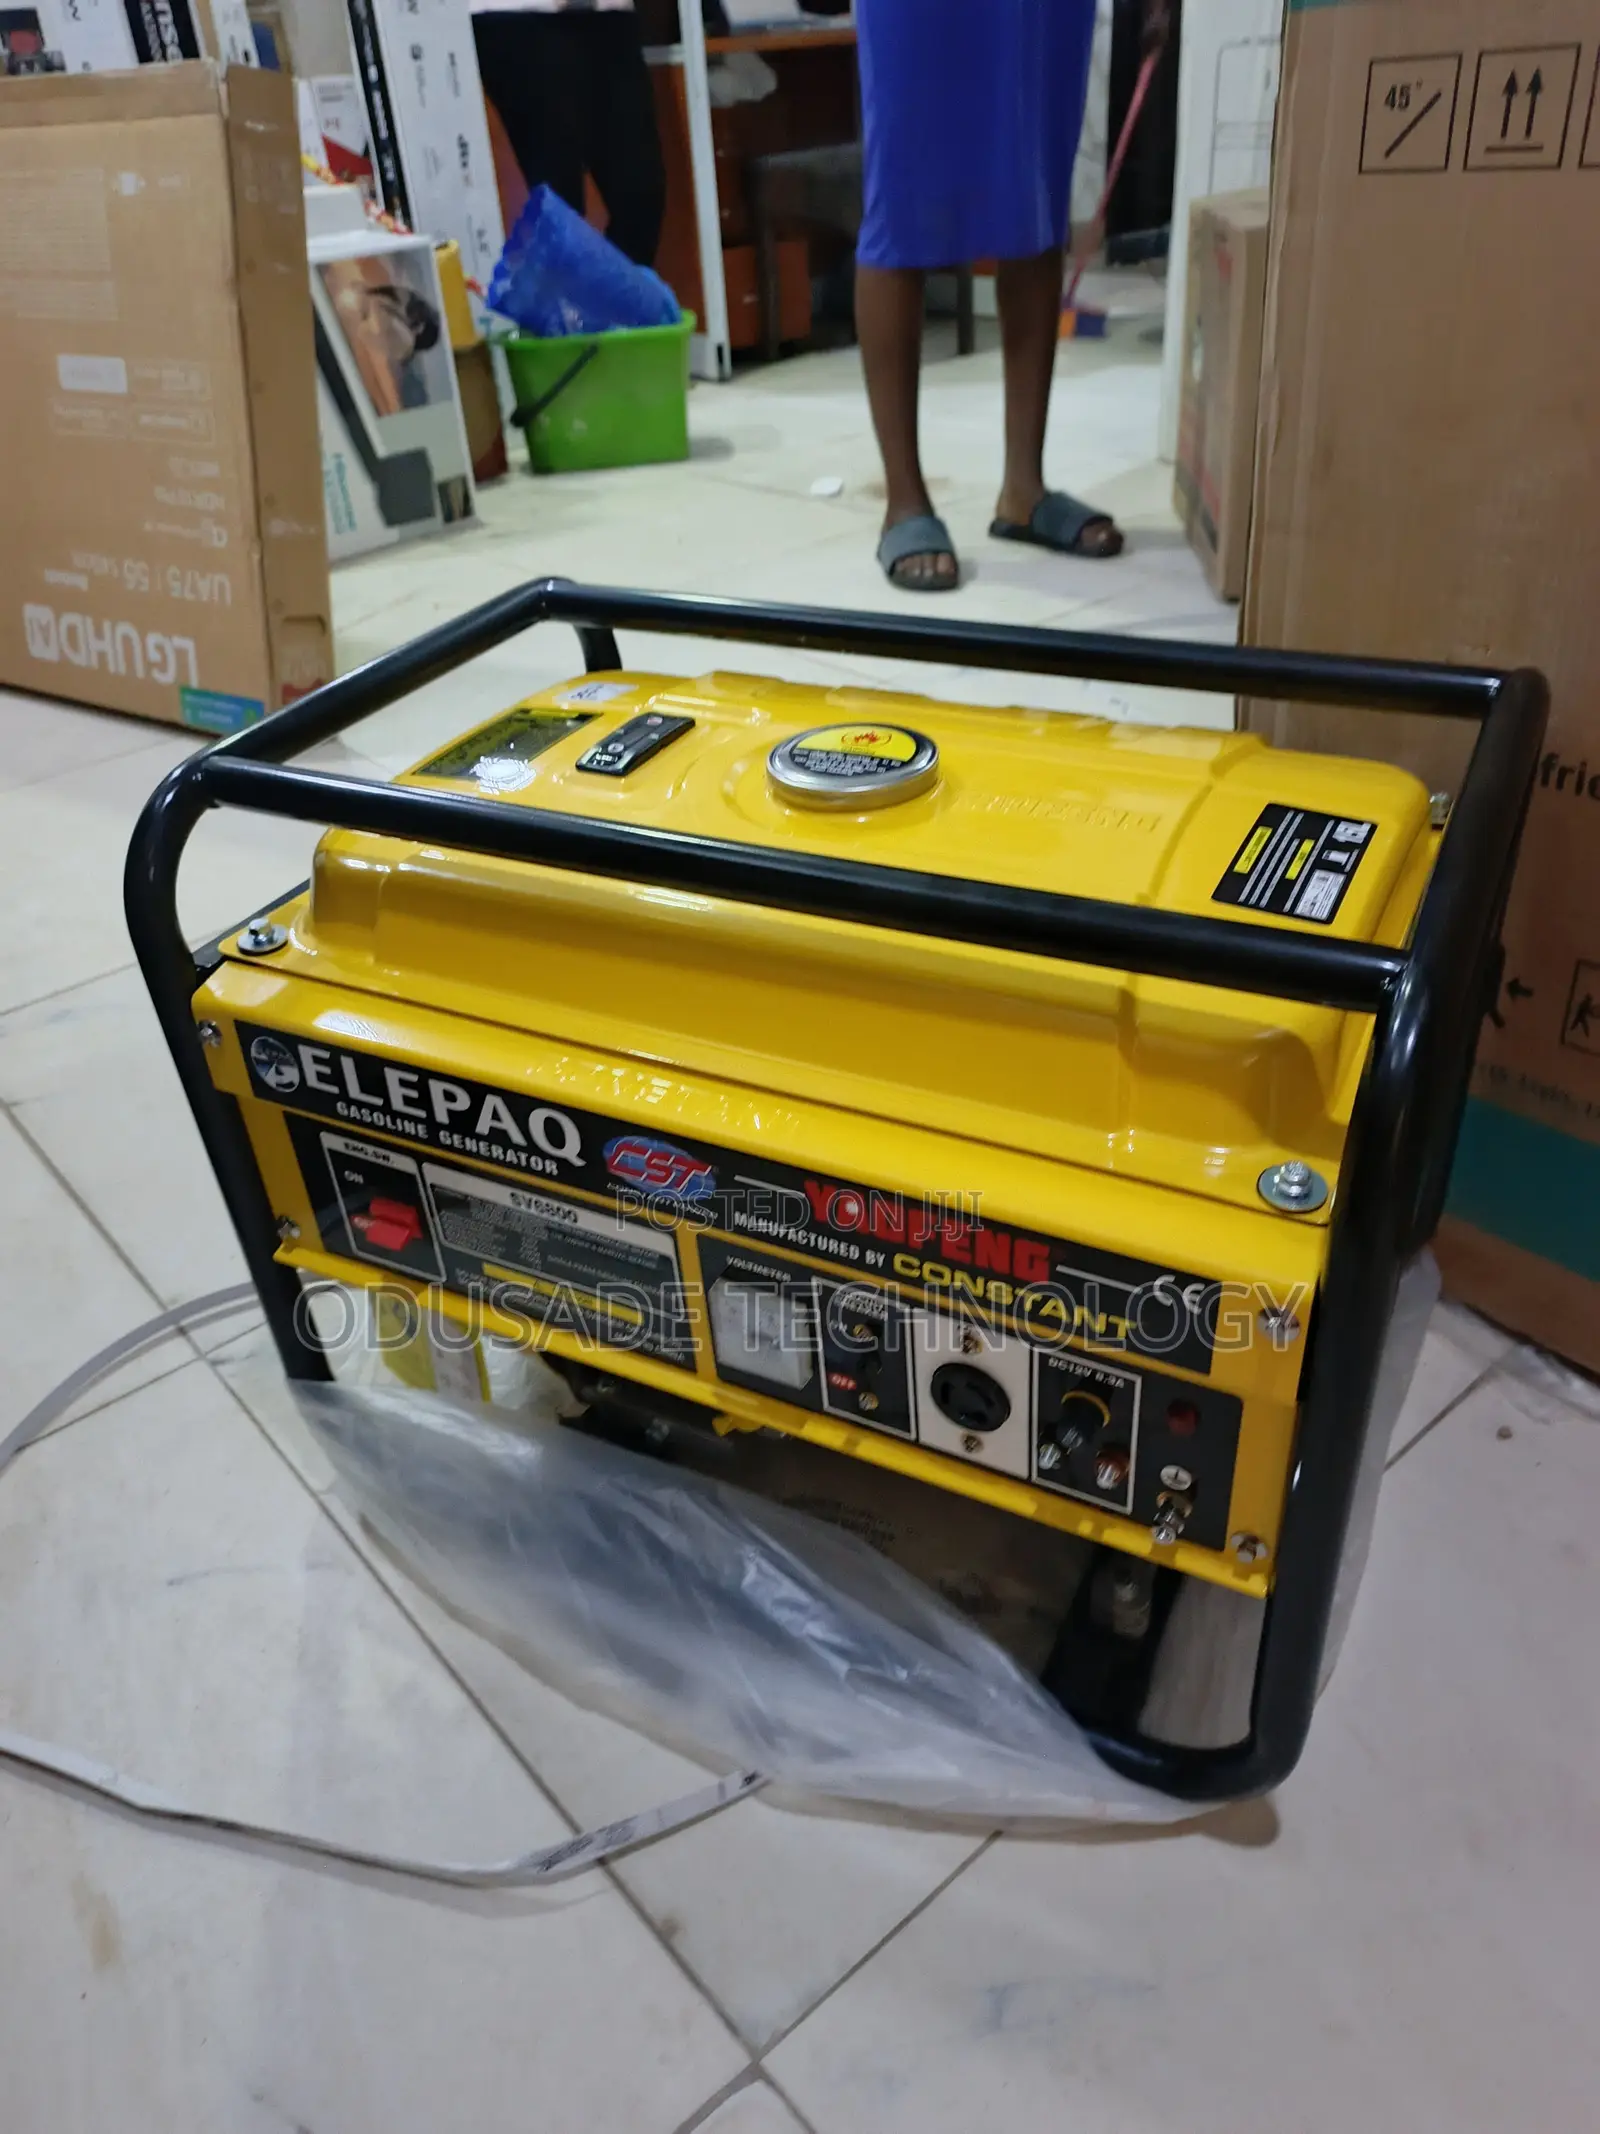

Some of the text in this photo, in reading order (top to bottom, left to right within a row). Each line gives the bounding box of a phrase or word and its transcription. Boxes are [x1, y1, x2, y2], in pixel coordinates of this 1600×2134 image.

[297, 1044, 587, 1166] ELEPAQ
[336, 1101, 560, 1177] GASOLINE GENERATOR
[607, 1141, 713, 1192] CST
[733, 1210, 860, 1261] MANUFACTURED
[865, 1248, 887, 1269] BY
[893, 1252, 1137, 1341] CONSTANT
